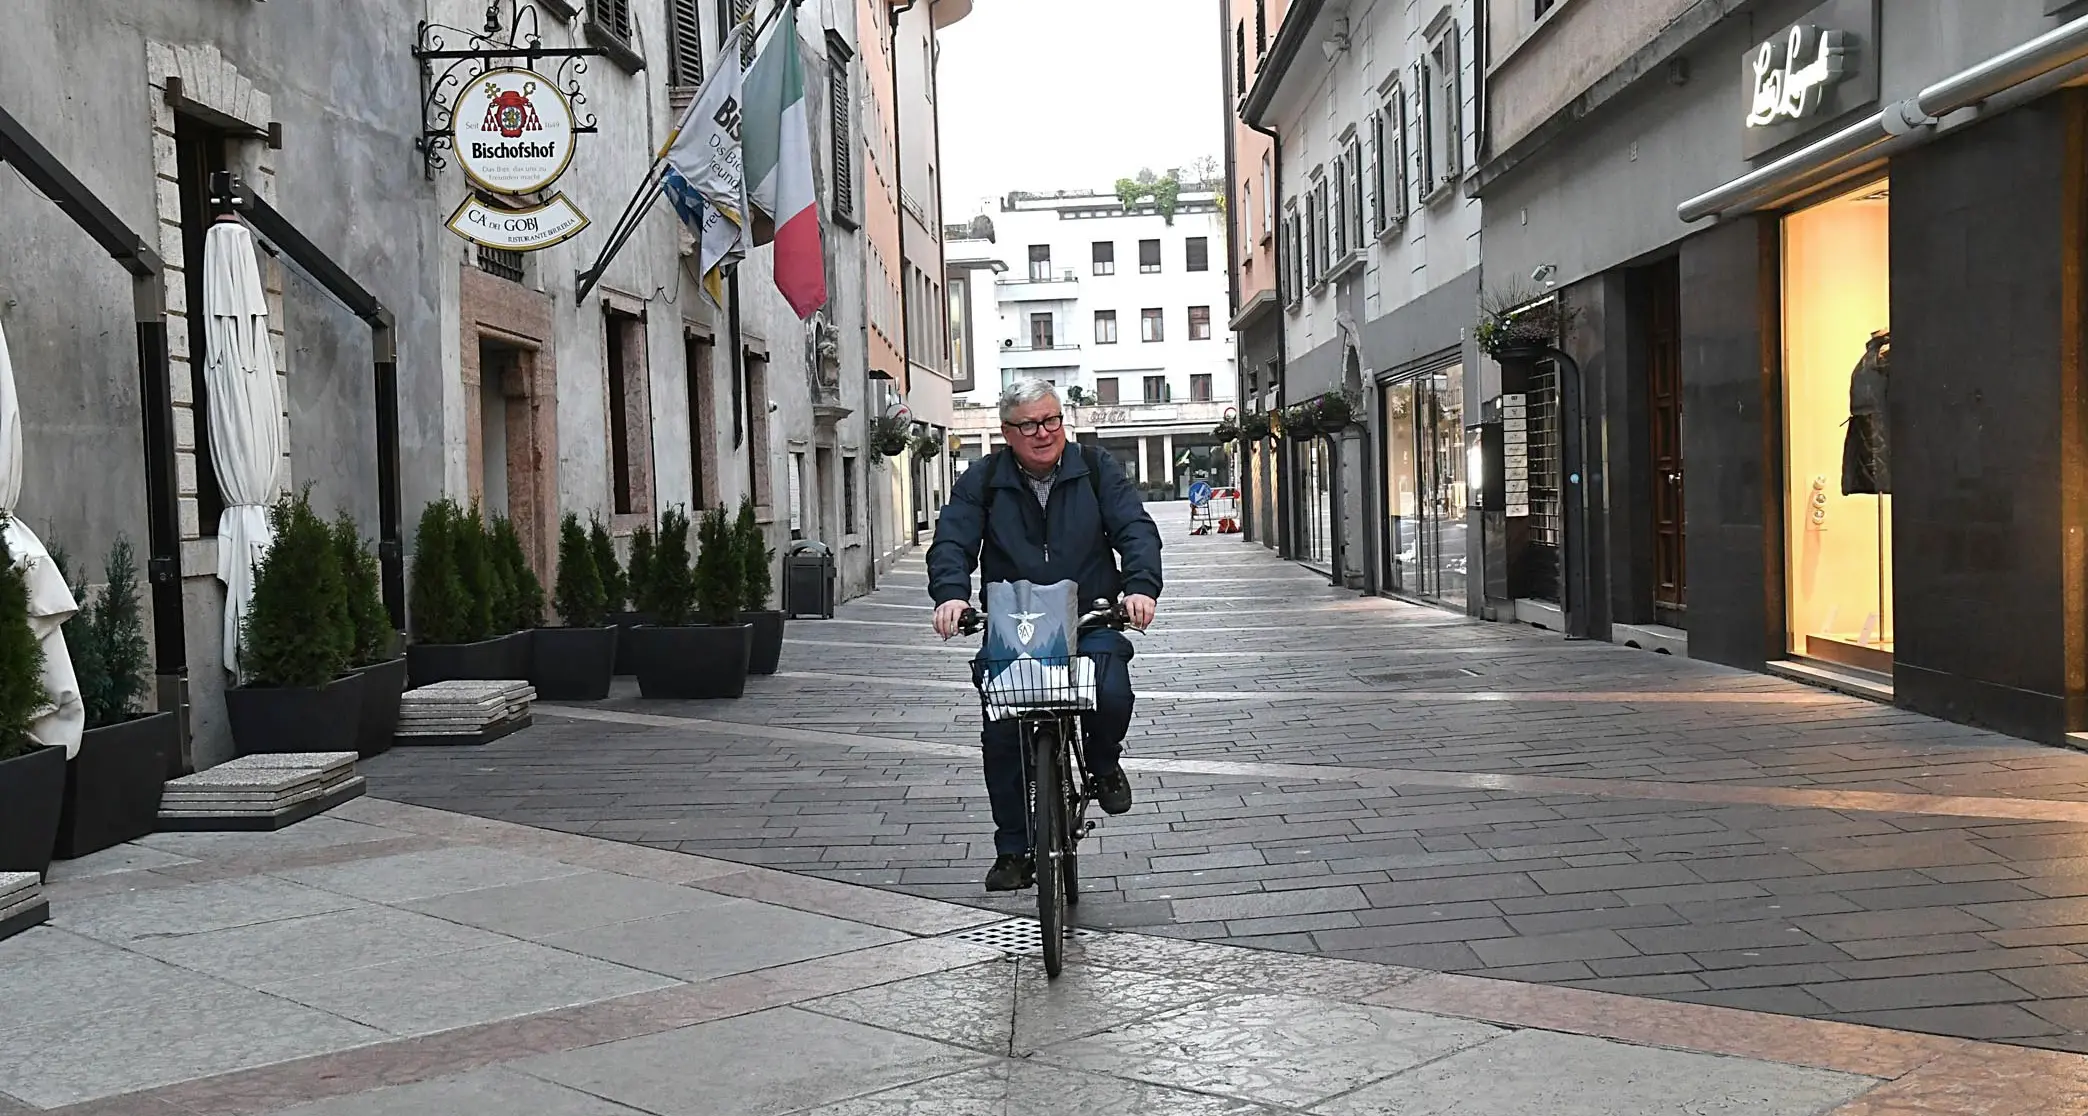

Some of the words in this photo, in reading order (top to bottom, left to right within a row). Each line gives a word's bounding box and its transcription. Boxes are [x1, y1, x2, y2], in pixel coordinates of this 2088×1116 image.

[465, 122, 479, 130] Seit
[472, 141, 555, 158] Bischofshof
[507, 231, 548, 243] RISTORANTE
[547, 219, 576, 236] BIRRERIA
